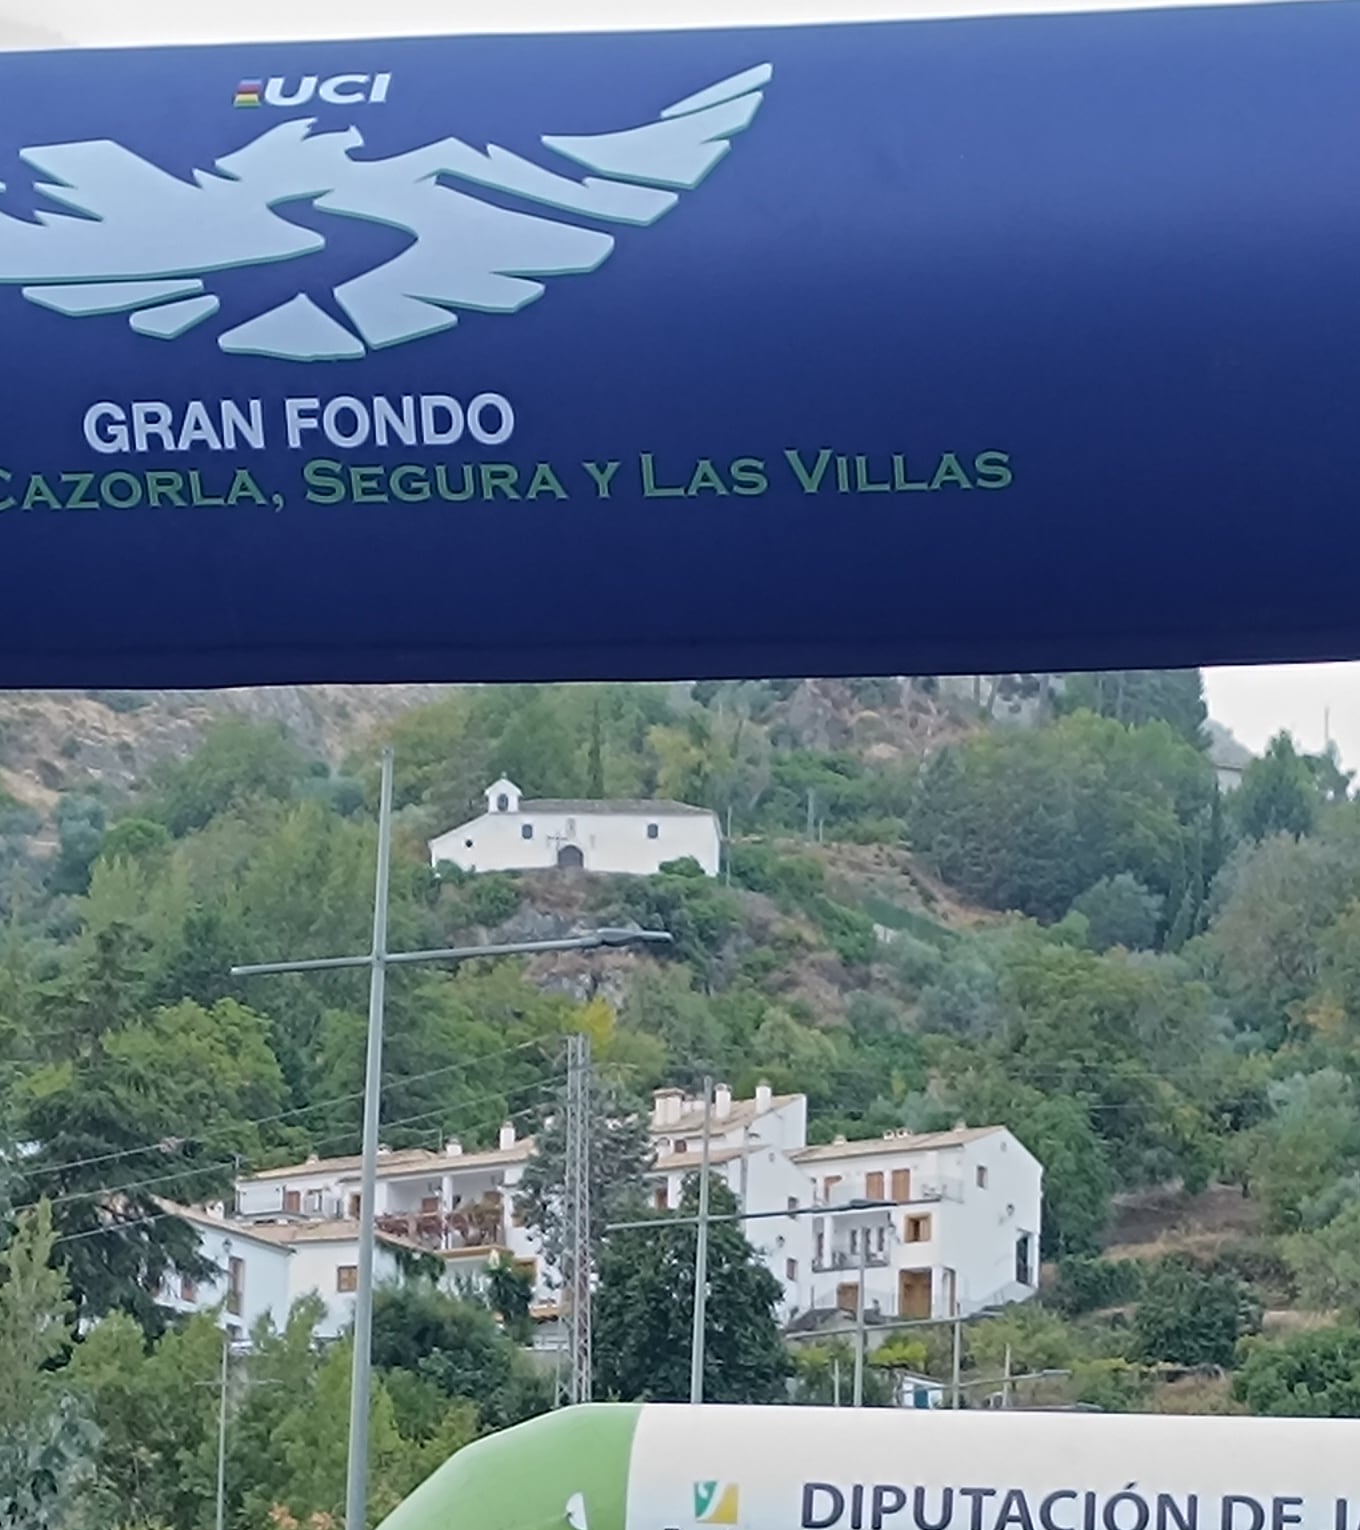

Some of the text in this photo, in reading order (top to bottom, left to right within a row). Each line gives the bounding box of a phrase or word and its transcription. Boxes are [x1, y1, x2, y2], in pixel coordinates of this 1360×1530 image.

[264, 71, 391, 105] UCI
[81, 392, 515, 454] GRAN FONDO
[303, 457, 569, 509] SEGURA
[582, 459, 622, 502] Y
[638, 447, 769, 499] LAS
[781, 443, 1014, 495] VILLAS
